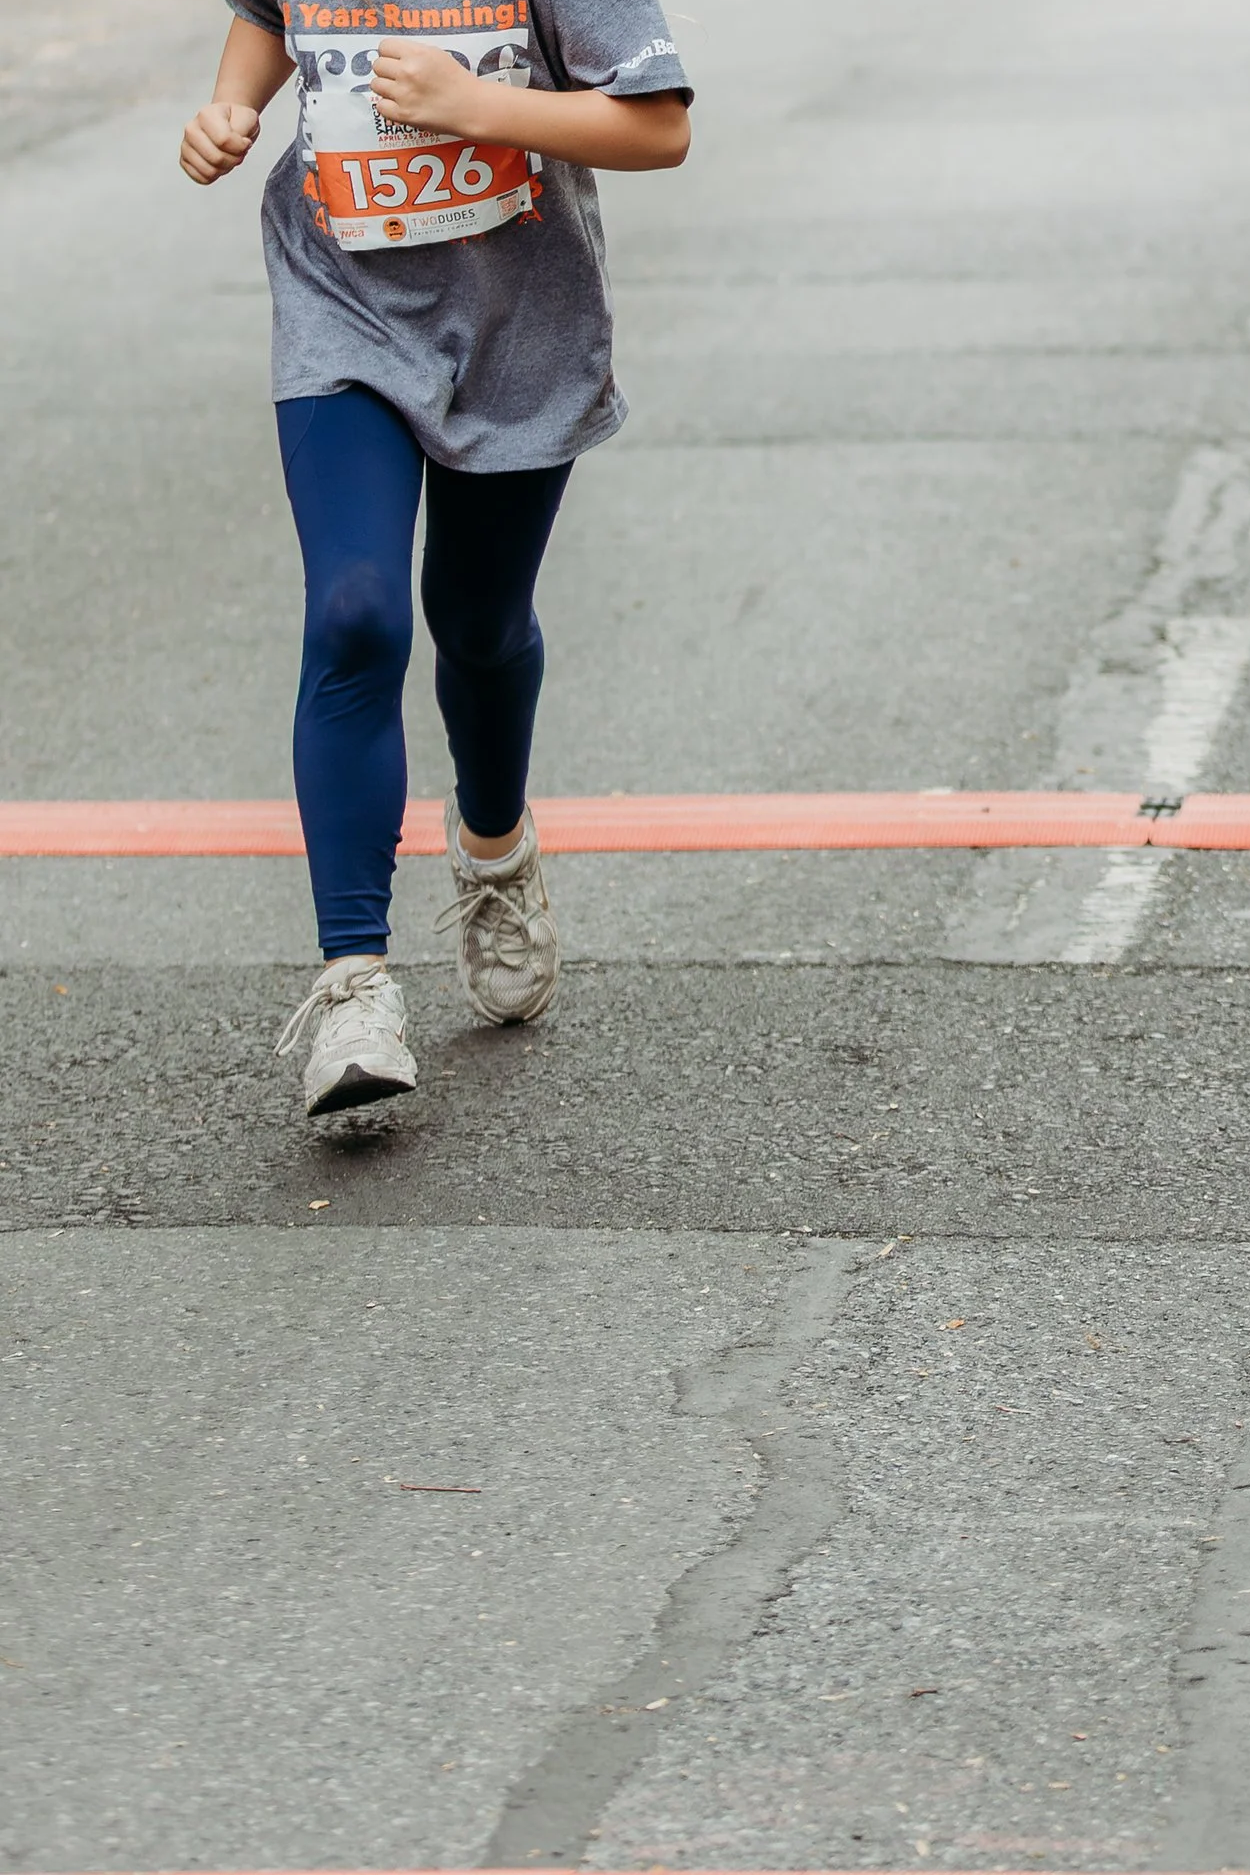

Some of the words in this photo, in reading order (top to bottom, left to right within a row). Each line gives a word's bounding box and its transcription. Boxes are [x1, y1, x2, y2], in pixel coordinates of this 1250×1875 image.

[298, 2, 378, 29] Years
[378, 133, 402, 142] APRIL
[341, 146, 494, 211] 1526
